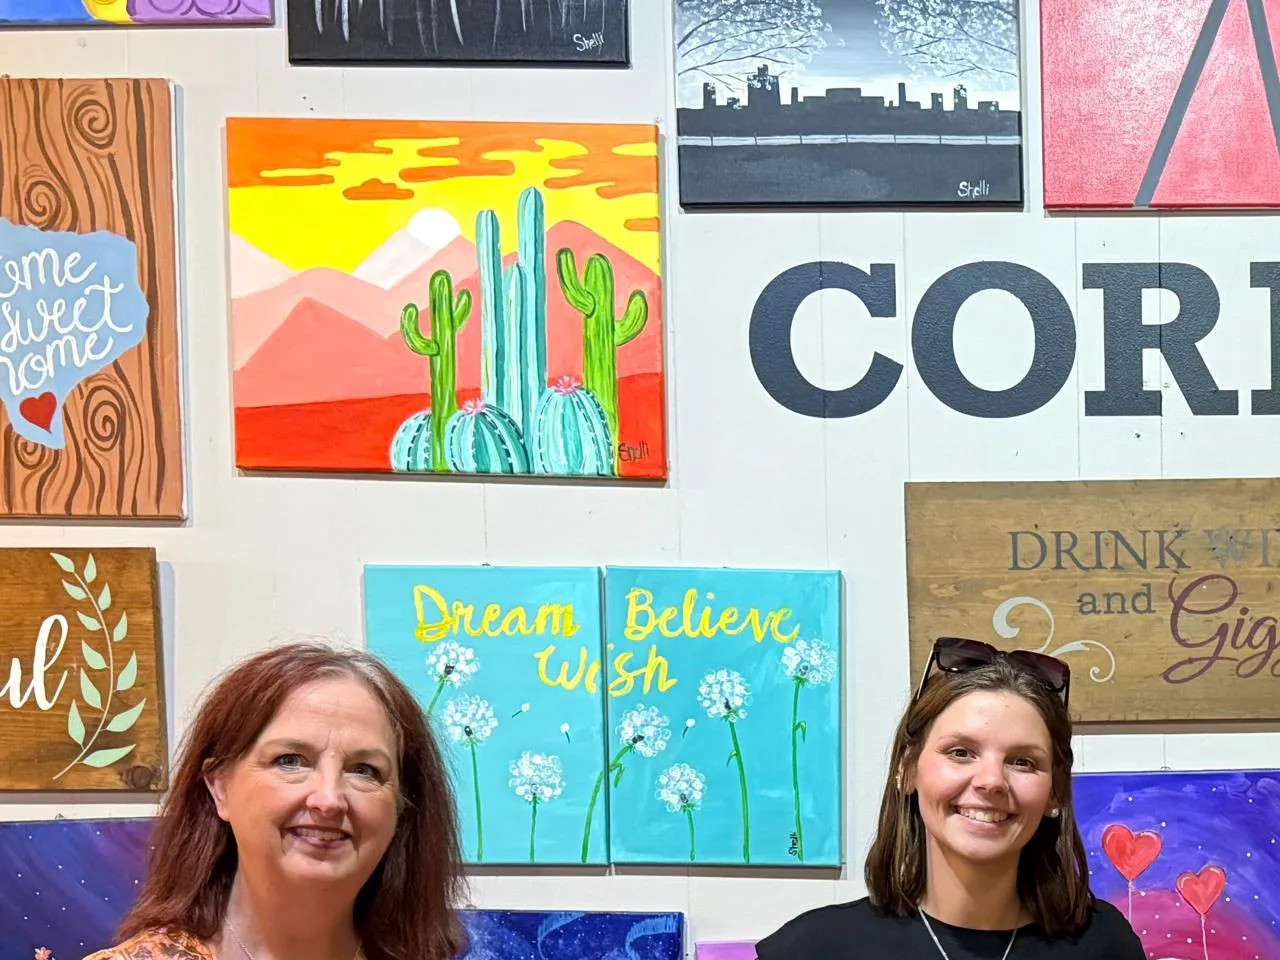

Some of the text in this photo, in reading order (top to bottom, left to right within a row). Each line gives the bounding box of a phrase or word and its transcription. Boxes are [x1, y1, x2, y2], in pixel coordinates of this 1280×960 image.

[1008, 529, 1192, 572] DRINK
[412, 584, 580, 643] Dream
[623, 587, 801, 644] Believe
[1078, 583, 1156, 617] and
